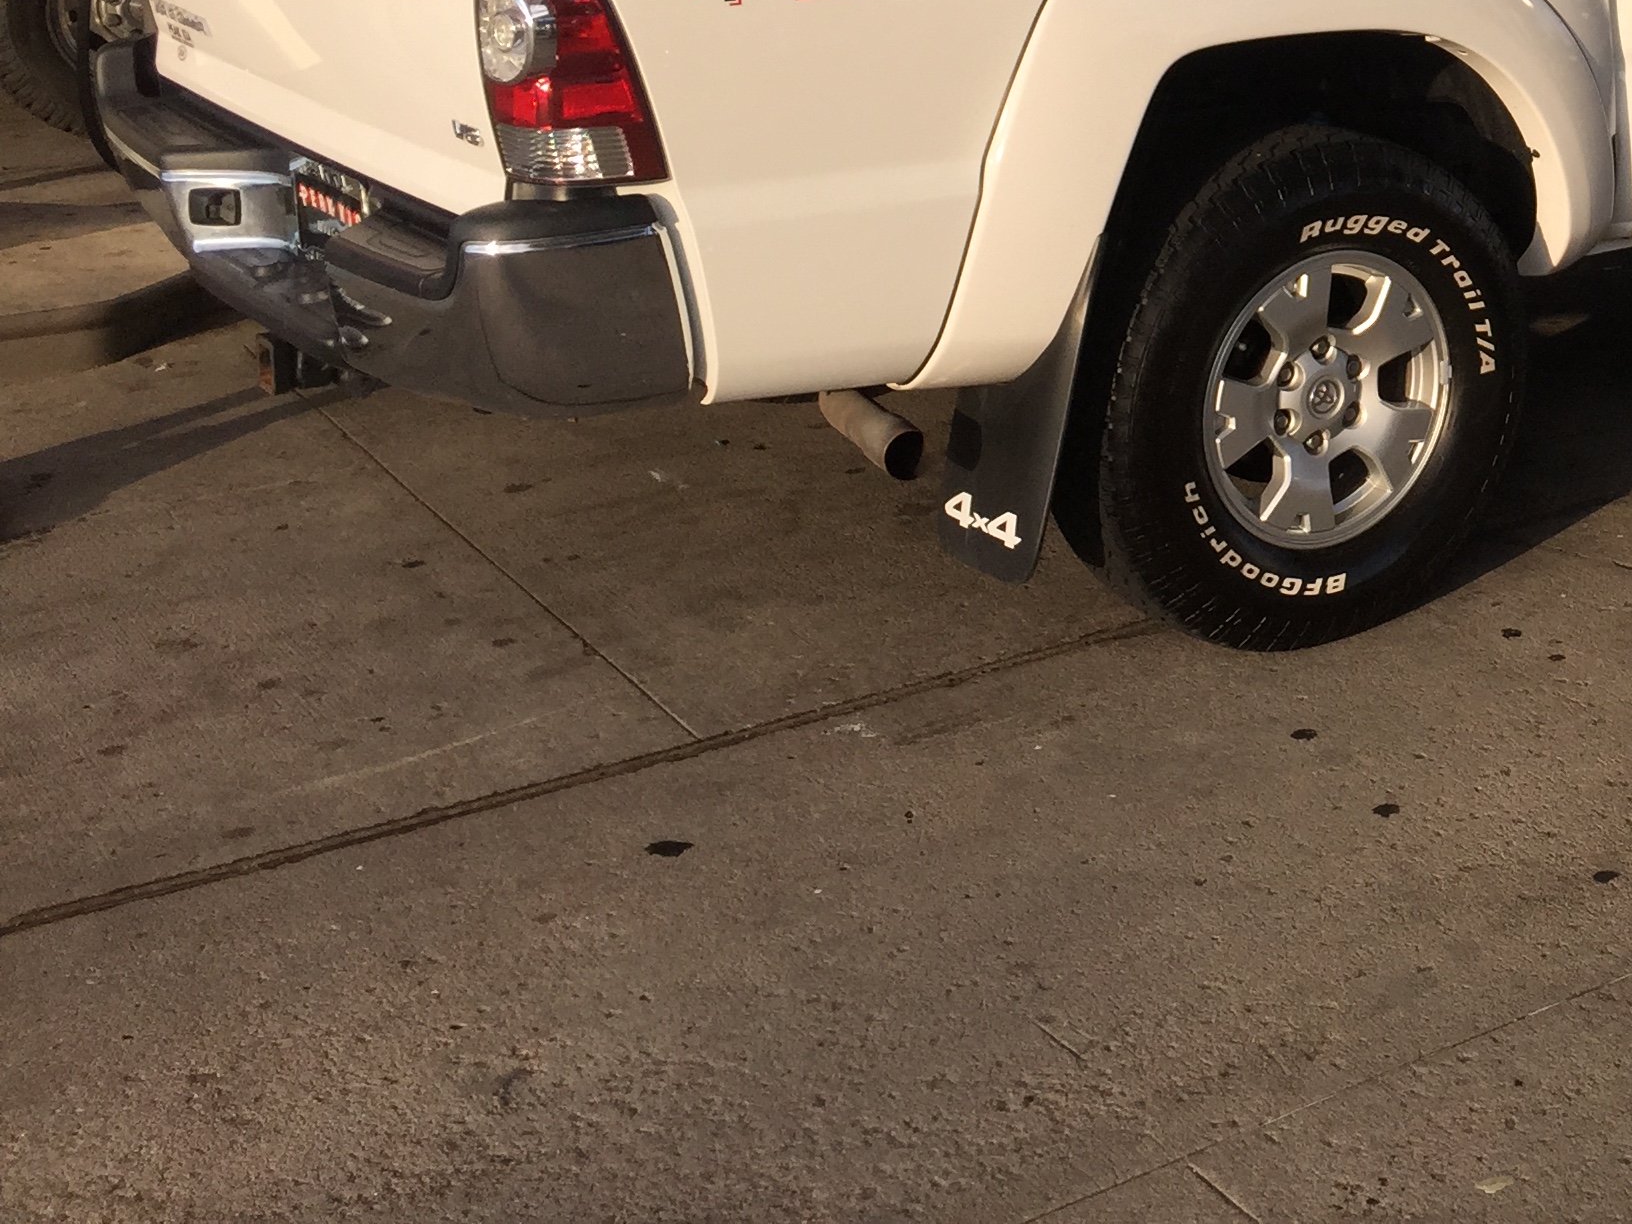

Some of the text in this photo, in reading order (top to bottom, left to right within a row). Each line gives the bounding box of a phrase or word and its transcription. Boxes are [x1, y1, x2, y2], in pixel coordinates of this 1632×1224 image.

[1299, 213, 1497, 376] Rugged Trail T/A
[943, 491, 1023, 550] 4x4
[1182, 480, 1348, 597] BFGoodrich
